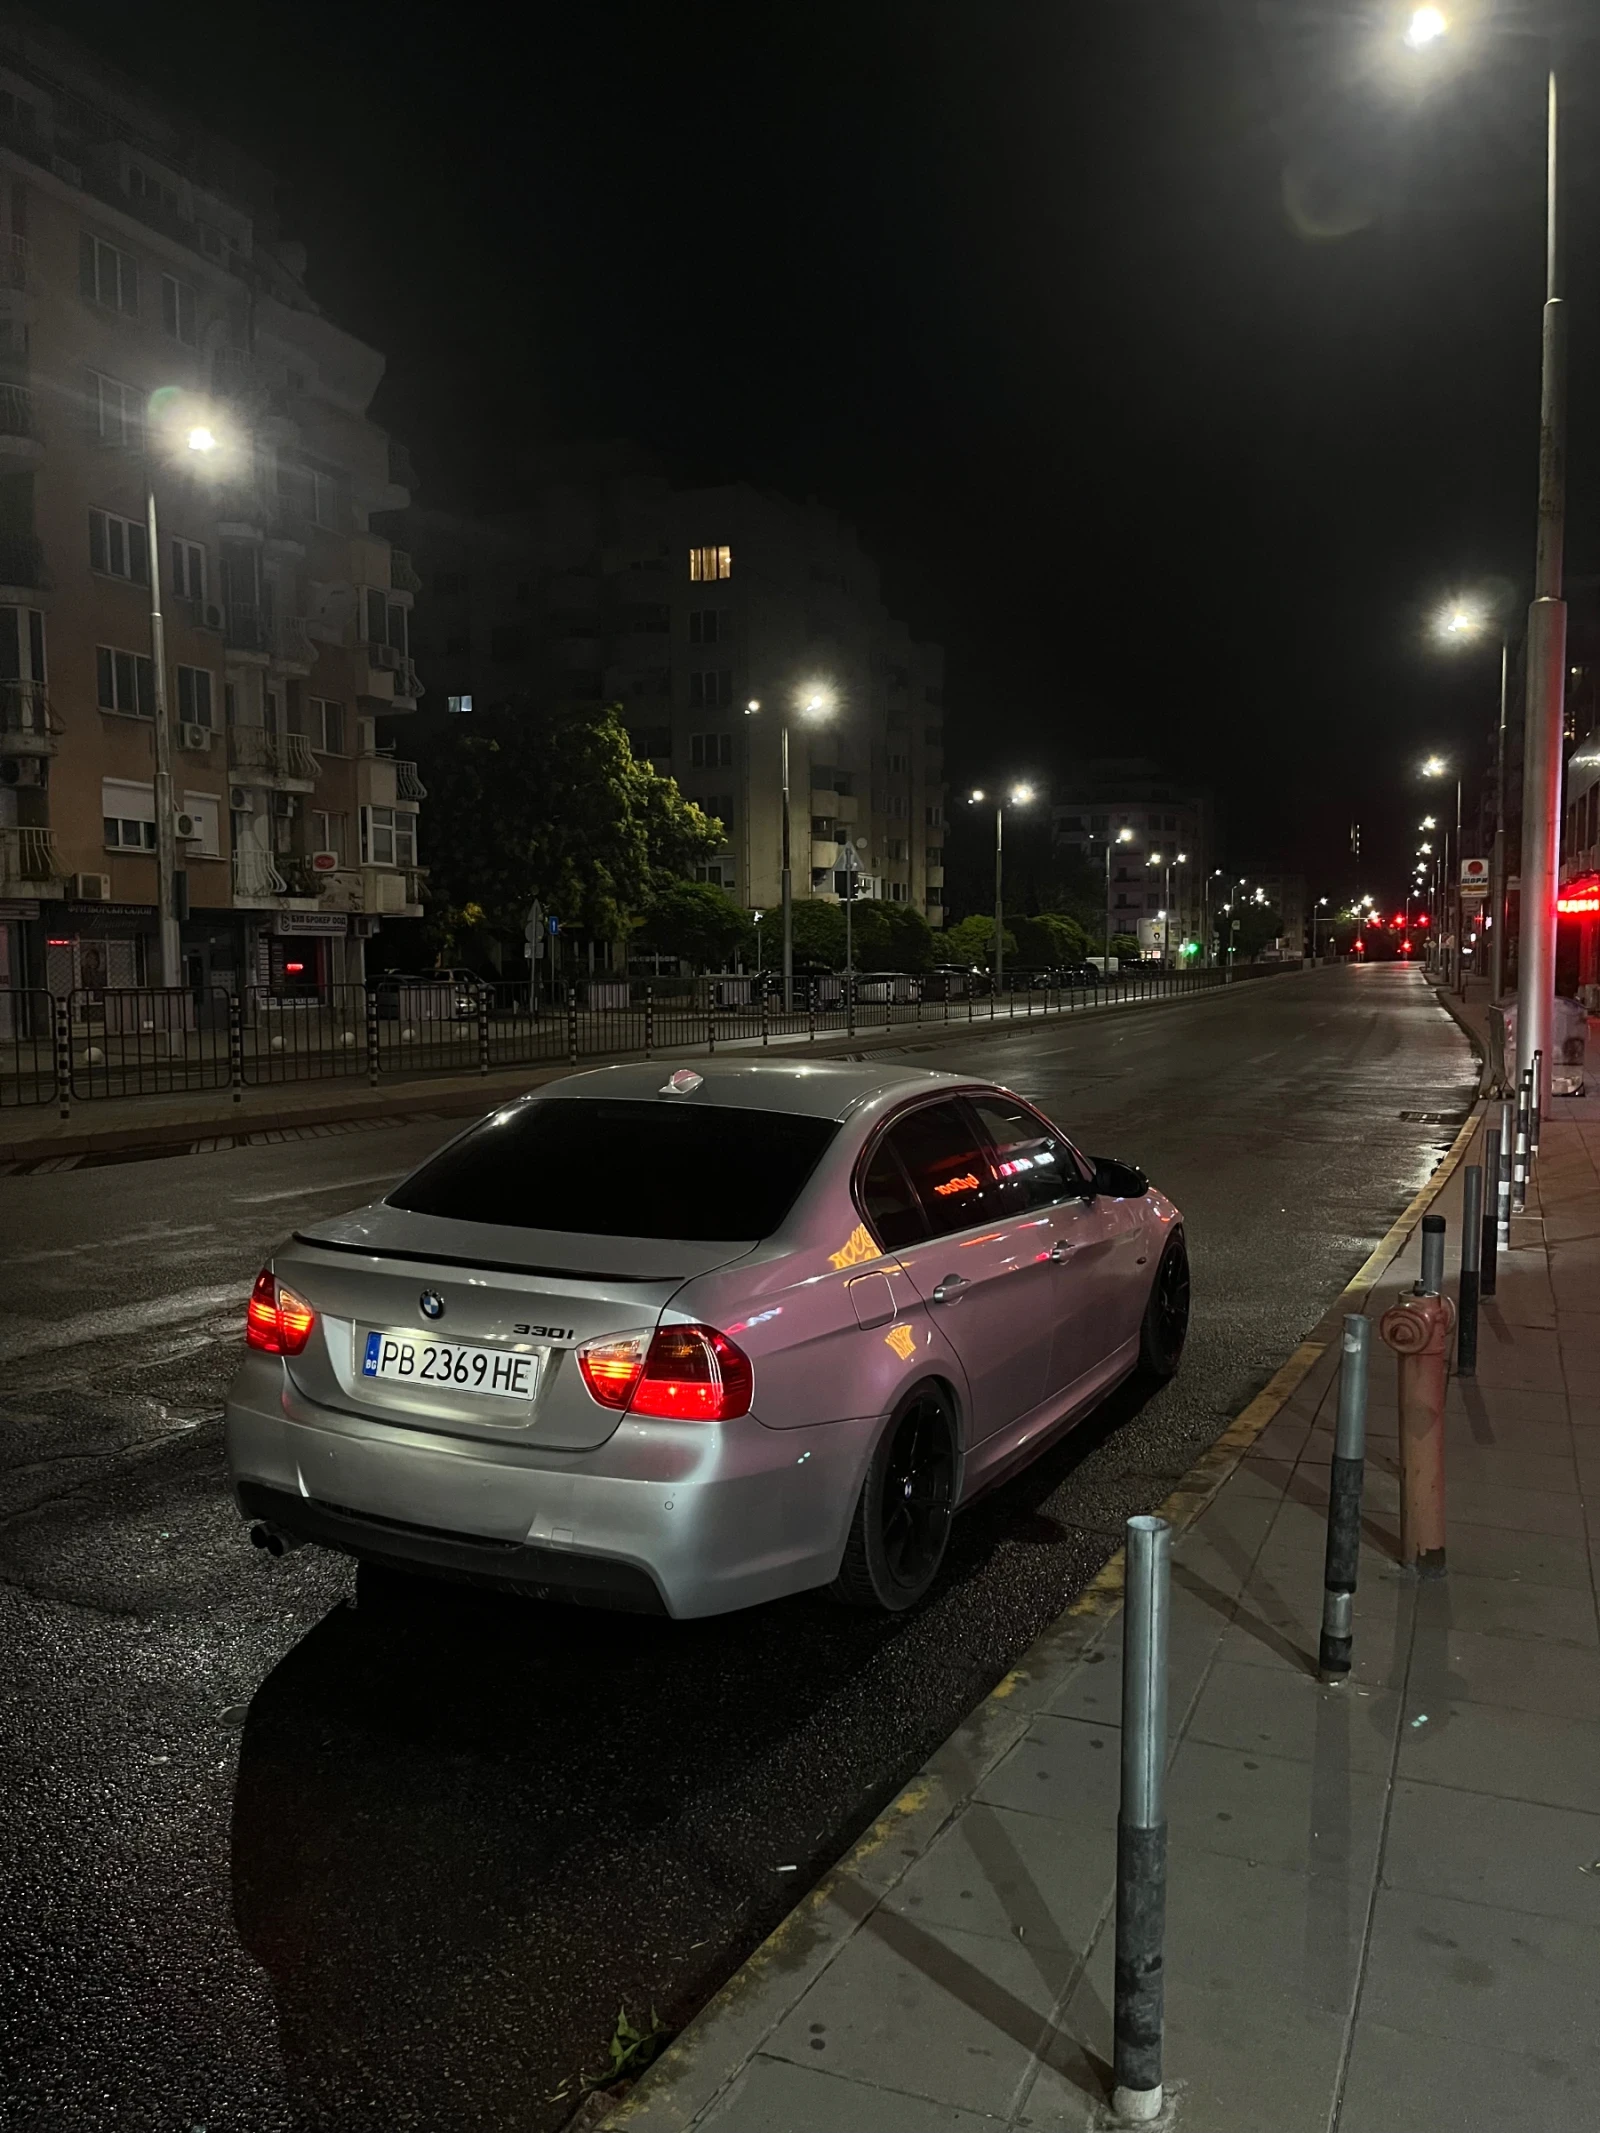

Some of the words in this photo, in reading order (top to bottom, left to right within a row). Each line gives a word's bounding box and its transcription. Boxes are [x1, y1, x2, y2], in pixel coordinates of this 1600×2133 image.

[306, 915, 331, 924] БРОКЕР
[365, 1358, 377, 1370] BG
[381, 1341, 415, 1376] PB
[420, 1349, 488, 1387] 2369
[492, 1356, 532, 1394] HE
